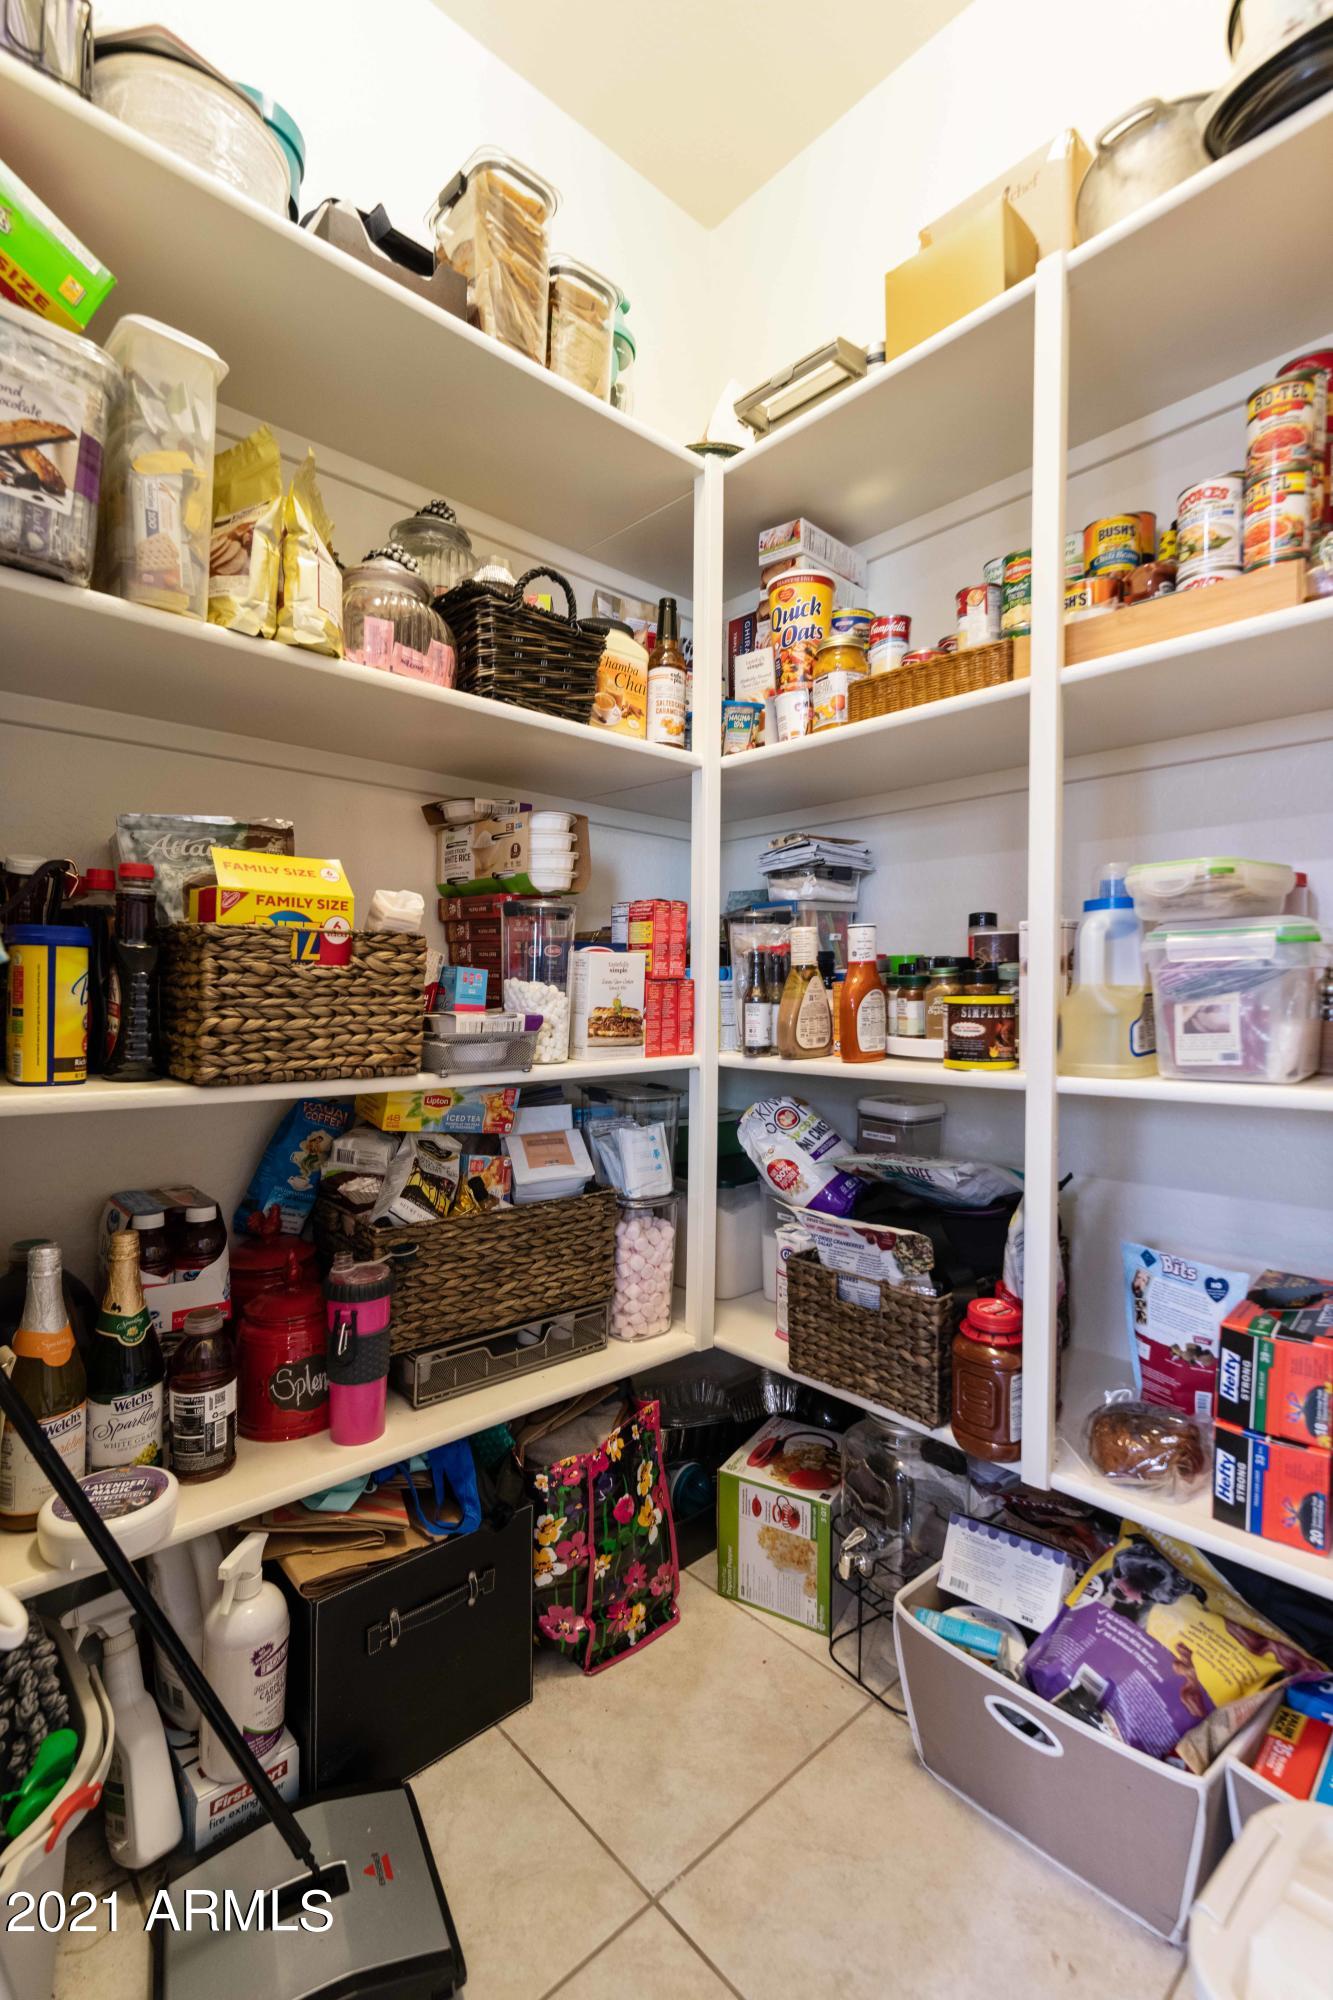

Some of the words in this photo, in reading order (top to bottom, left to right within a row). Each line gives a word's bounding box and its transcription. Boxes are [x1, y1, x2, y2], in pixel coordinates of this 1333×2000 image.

[1097, 524, 1136, 542] BUSH'S
[771, 596, 822, 632] Quick
[781, 624, 823, 648] Oats
[870, 621, 907, 635] Campbell's
[614, 671, 647, 696] Chai
[458, 852, 472, 862] RICE
[222, 861, 280, 875] FAMILY
[283, 866, 317, 878] SIZE
[256, 894, 314, 908] FAMILY
[317, 899, 349, 912] SIZE
[960, 1006, 1000, 1019] SIMPLE
[426, 1095, 449, 1106] Lipton
[446, 1113, 467, 1123] ICED
[467, 1114, 481, 1122] TEA
[906, 1165, 936, 1183] FREE
[1160, 1253, 1198, 1281] Bits
[1222, 1352, 1242, 1399] Hefty
[1240, 1360, 1253, 1401] STRONG
[114, 1391, 153, 1413] Welch's
[44, 1411, 82, 1438] Welch's
[92, 1407, 161, 1443] Sparkling
[103, 1439, 133, 1450] WHITE
[84, 1479, 146, 1492] LAVENDER
[1217, 1455, 1236, 1502] Hefty
[1235, 1462, 1248, 1503] STRONG
[91, 1486, 132, 1496] MAGIC
[1309, 1529, 1324, 1547] 20
[212, 1783, 248, 1813] First
[208, 1815, 226, 1831] fire
